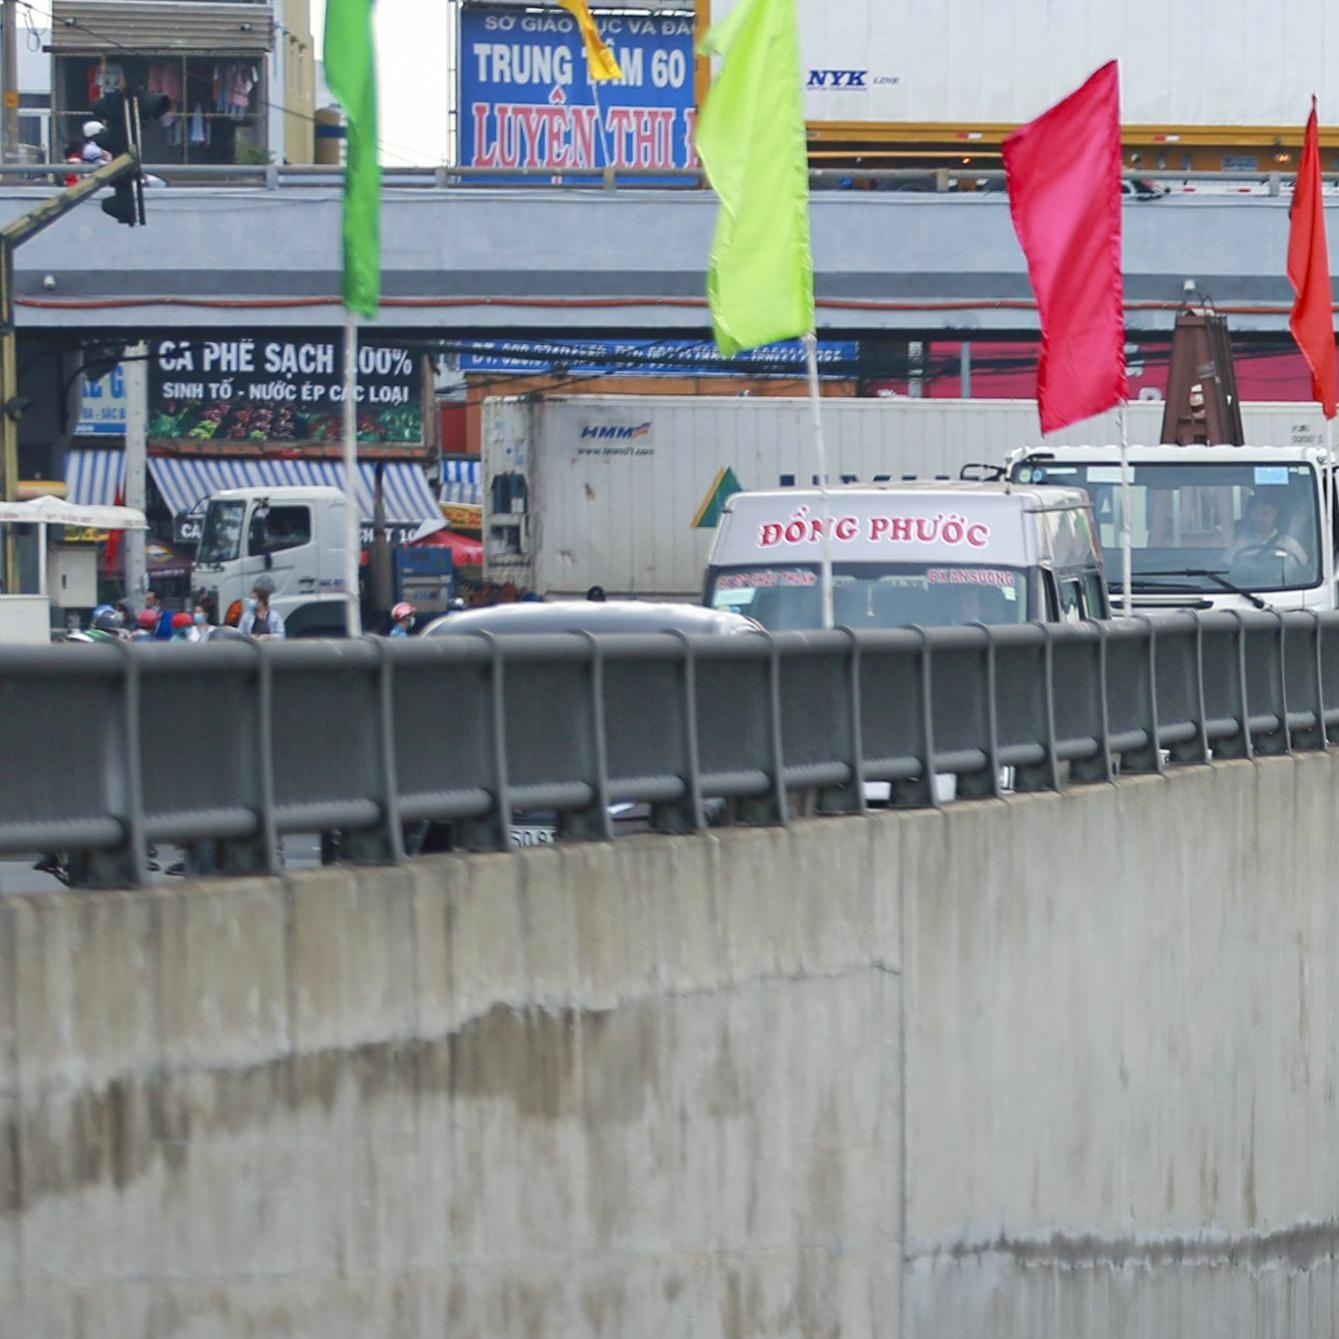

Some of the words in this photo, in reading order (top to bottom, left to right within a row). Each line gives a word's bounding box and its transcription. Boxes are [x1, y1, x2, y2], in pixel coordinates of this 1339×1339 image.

[473, 43, 573, 85] TRUNG
[651, 49, 686, 88] 60
[807, 70, 868, 86] NYK
[605, 105, 677, 169] THI
[264, 342, 334, 379] SẠCH
[162, 382, 204, 399] SINH
[208, 377, 234, 399] TỐ
[301, 379, 326, 401] ÉP
[369, 385, 409, 406] LOẠI
[581, 426, 634, 438] HMM
[868, 514, 990, 548] PHƯỚC
